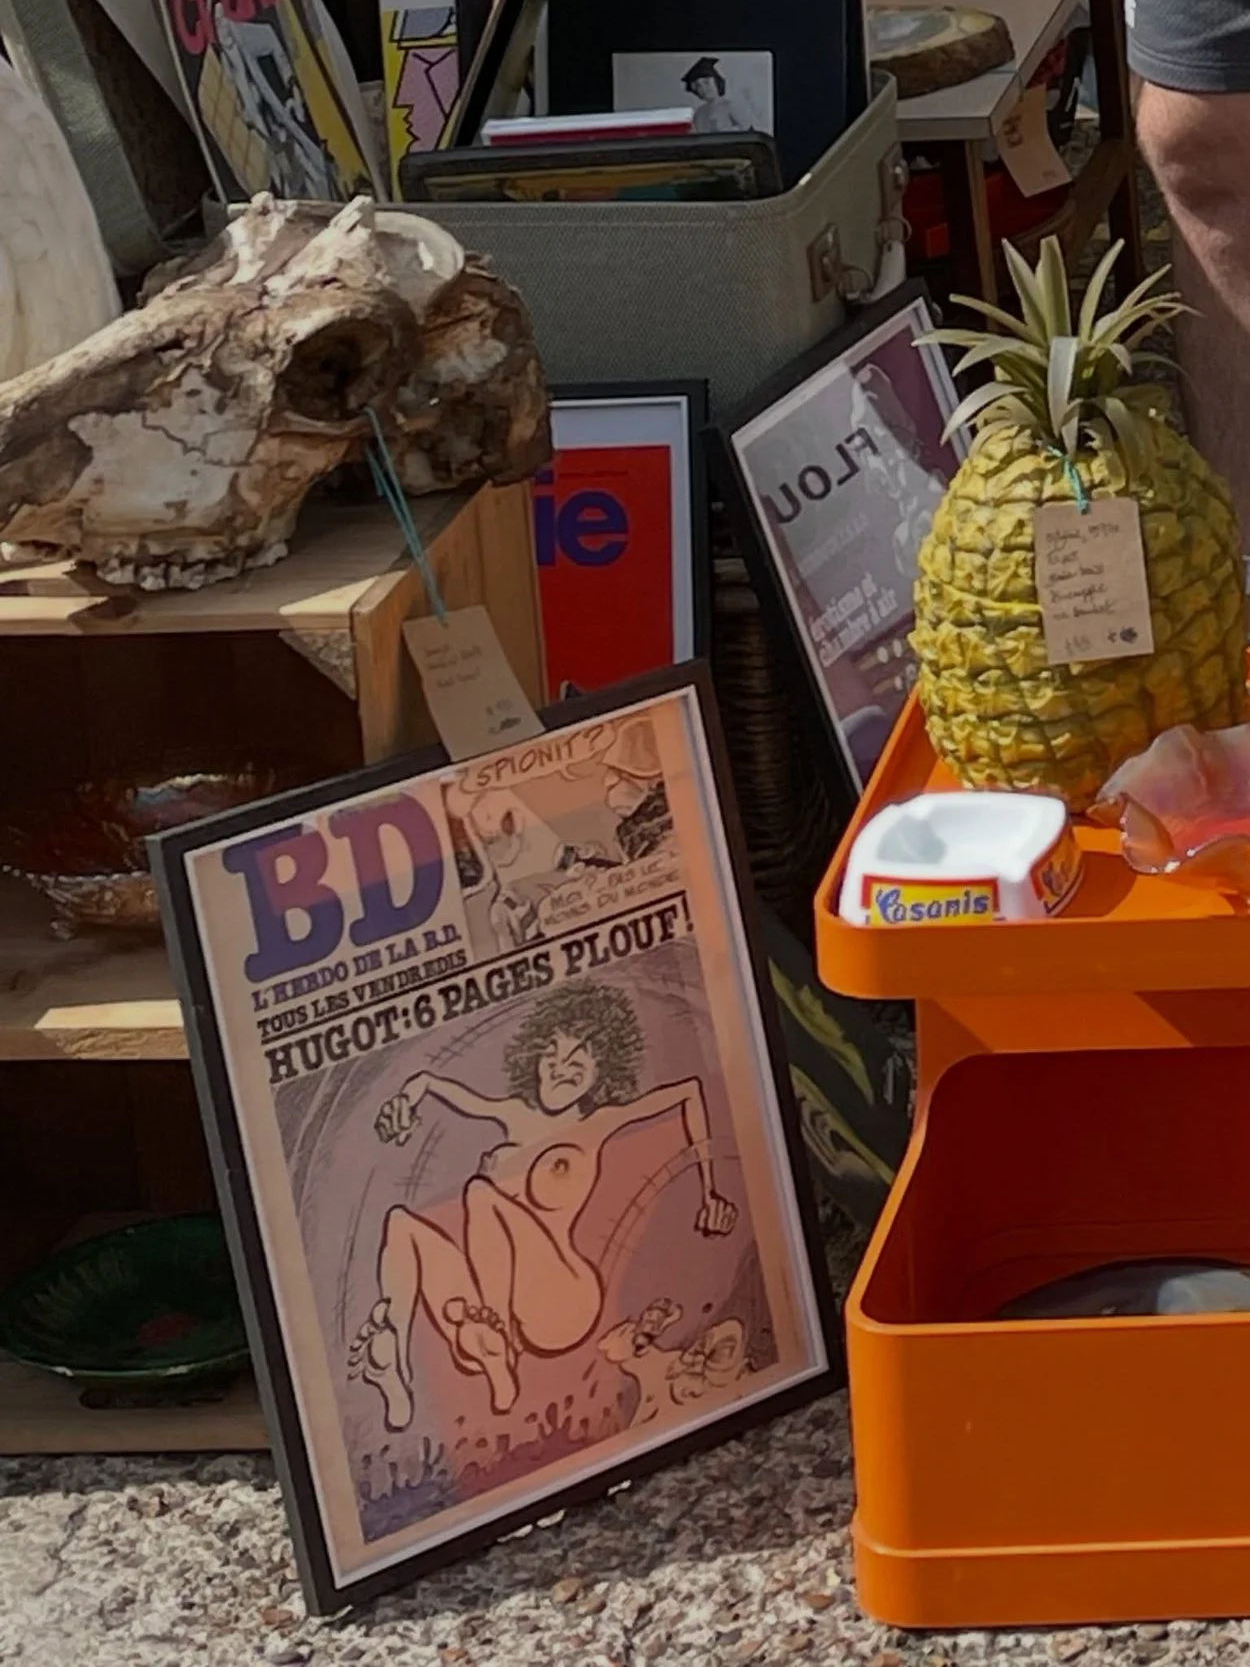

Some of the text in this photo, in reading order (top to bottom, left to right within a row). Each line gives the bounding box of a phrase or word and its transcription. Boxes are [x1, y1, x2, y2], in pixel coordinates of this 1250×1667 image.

[534, 470, 630, 567] ie
[222, 794, 444, 984] BD
[257, 948, 468, 1039] TOUS LES VENDREDIS
[353, 949, 382, 977] DE
[385, 937, 418, 965] LA
[438, 951, 555, 1022] PAGES
[561, 897, 694, 977] PLOUF!
